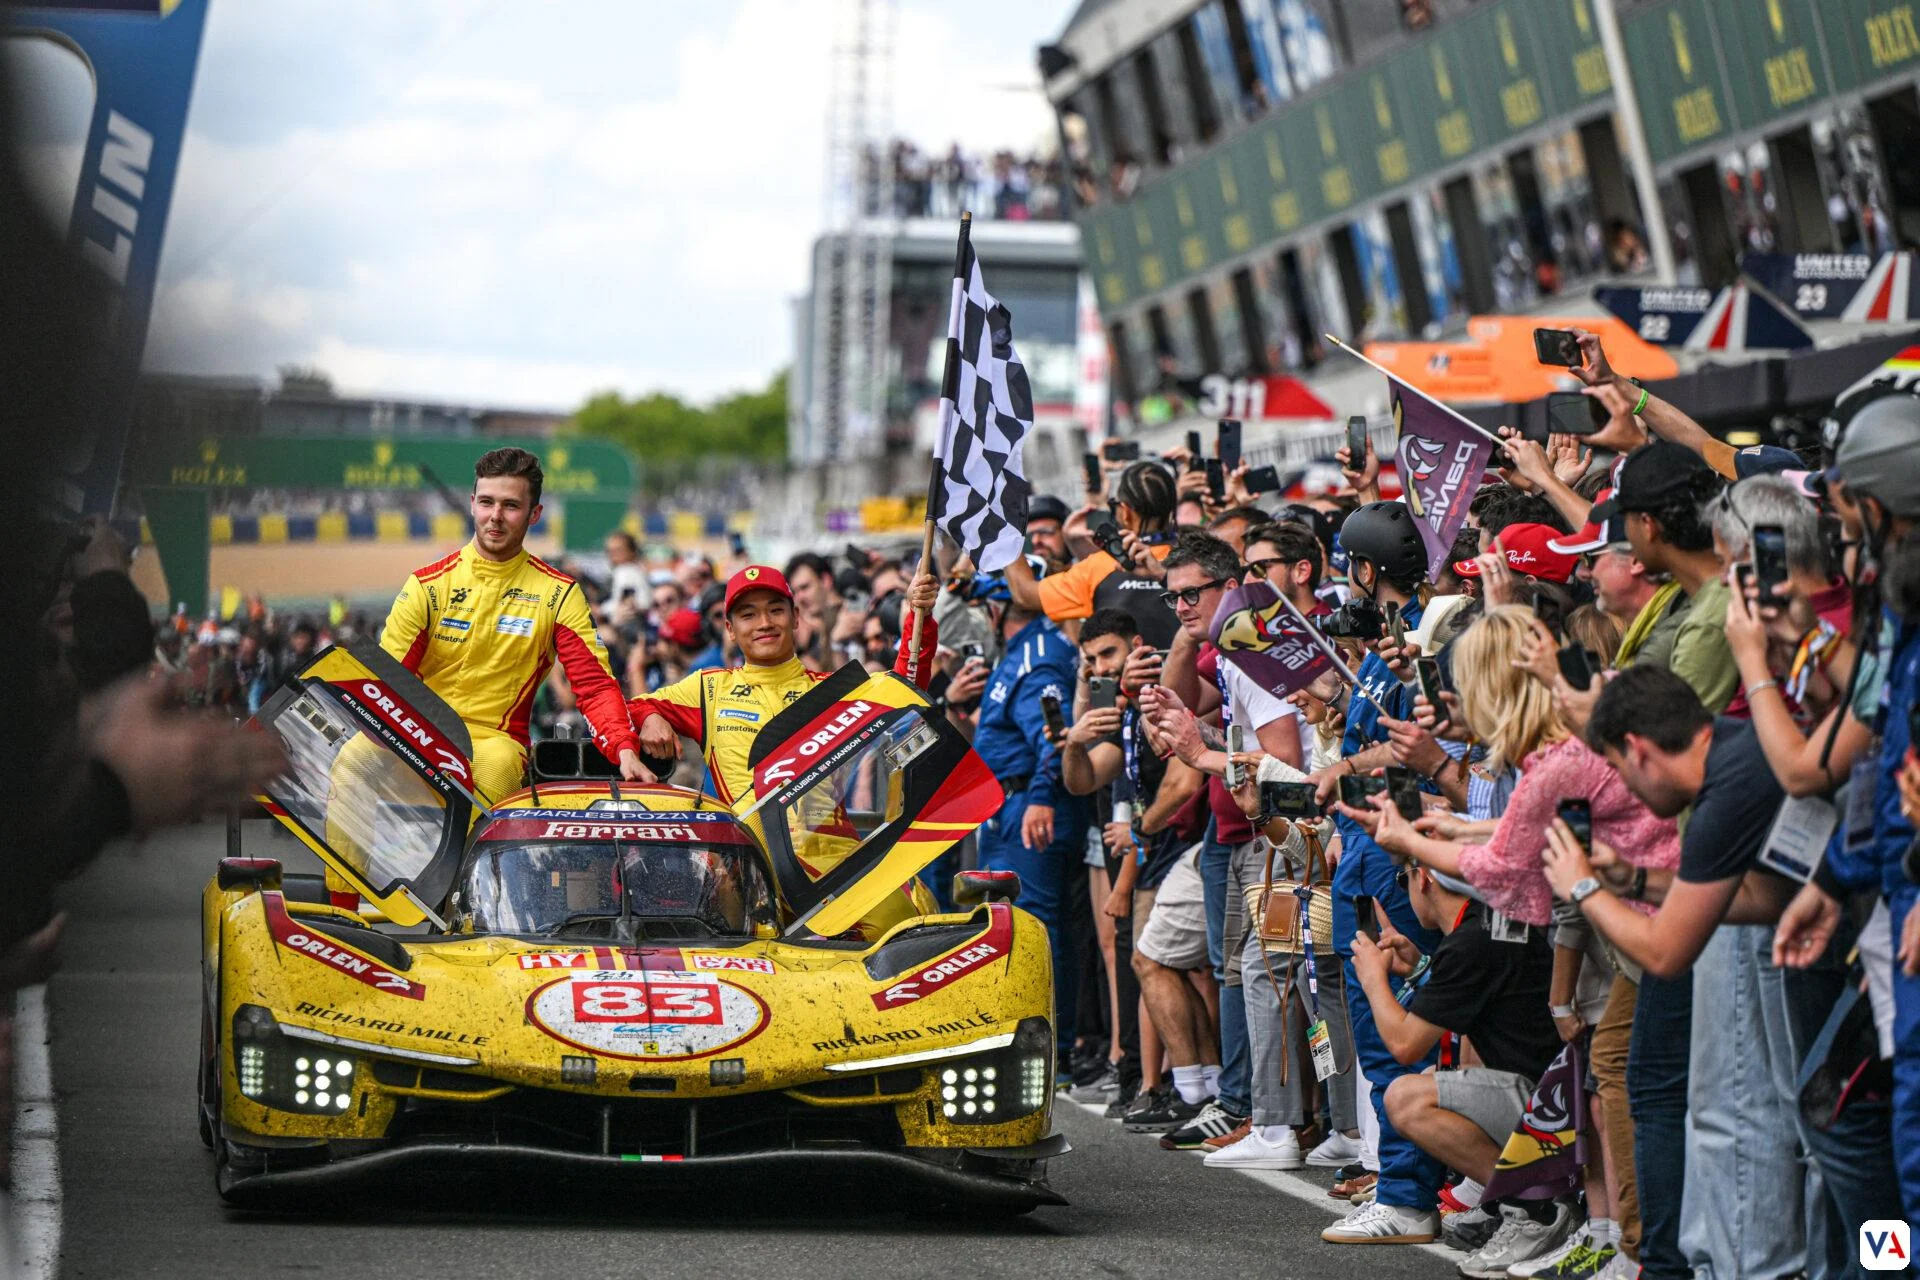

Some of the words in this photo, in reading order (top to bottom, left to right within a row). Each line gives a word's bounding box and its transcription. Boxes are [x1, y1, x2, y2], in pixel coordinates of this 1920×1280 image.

[1795, 283, 1828, 311] 23
[1639, 314, 1671, 341] 22
[1201, 374, 1267, 420] 311
[1506, 549, 1537, 564] Ray-Ban
[426, 585, 439, 611] Sabelt
[547, 584, 563, 610] Sabelt
[362, 683, 435, 747] ORLEN
[799, 700, 873, 756] ORLEN
[356, 707, 383, 731] KUBICA
[397, 742, 426, 770] HANSON
[439, 780, 451, 792] YE
[793, 771, 820, 793] KUBICA
[832, 737, 862, 762] HANSON
[873, 718, 886, 729] YE
[508, 809, 616, 820] CHARLES
[620, 812, 689, 820] POZZI
[539, 822, 702, 841] Ferrari
[286, 934, 372, 974] ORLEN
[521, 953, 581, 969] HY
[700, 960, 768, 972] CAR
[922, 943, 998, 983] ORLEN
[581, 985, 715, 1019] 83
[295, 1001, 407, 1034] RICHARD
[409, 1026, 491, 1047] MILLE
[812, 1028, 923, 1053] RICHARD
[927, 1012, 998, 1036] MILLE
